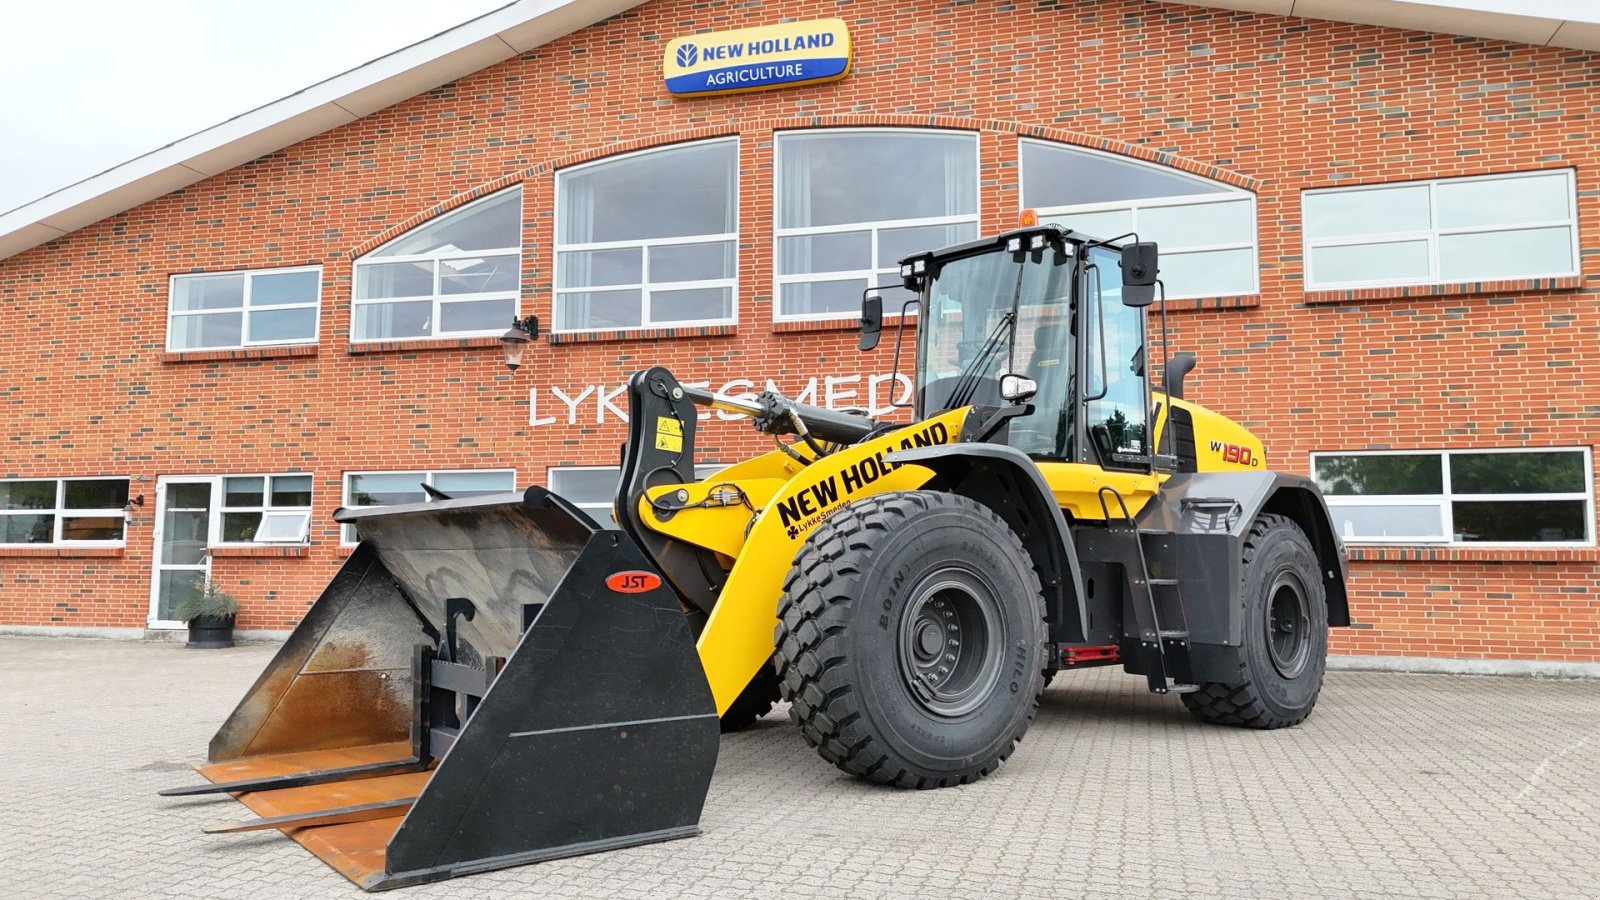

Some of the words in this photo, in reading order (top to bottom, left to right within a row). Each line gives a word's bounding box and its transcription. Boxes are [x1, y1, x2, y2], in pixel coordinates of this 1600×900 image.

[703, 43, 744, 62] NEW
[748, 32, 834, 57] HOLLAND
[706, 63, 803, 87] AGRICULTURE
[529, 372, 913, 426] LYKSMED
[776, 475, 839, 528] NEW
[620, 575, 648, 589] JST
